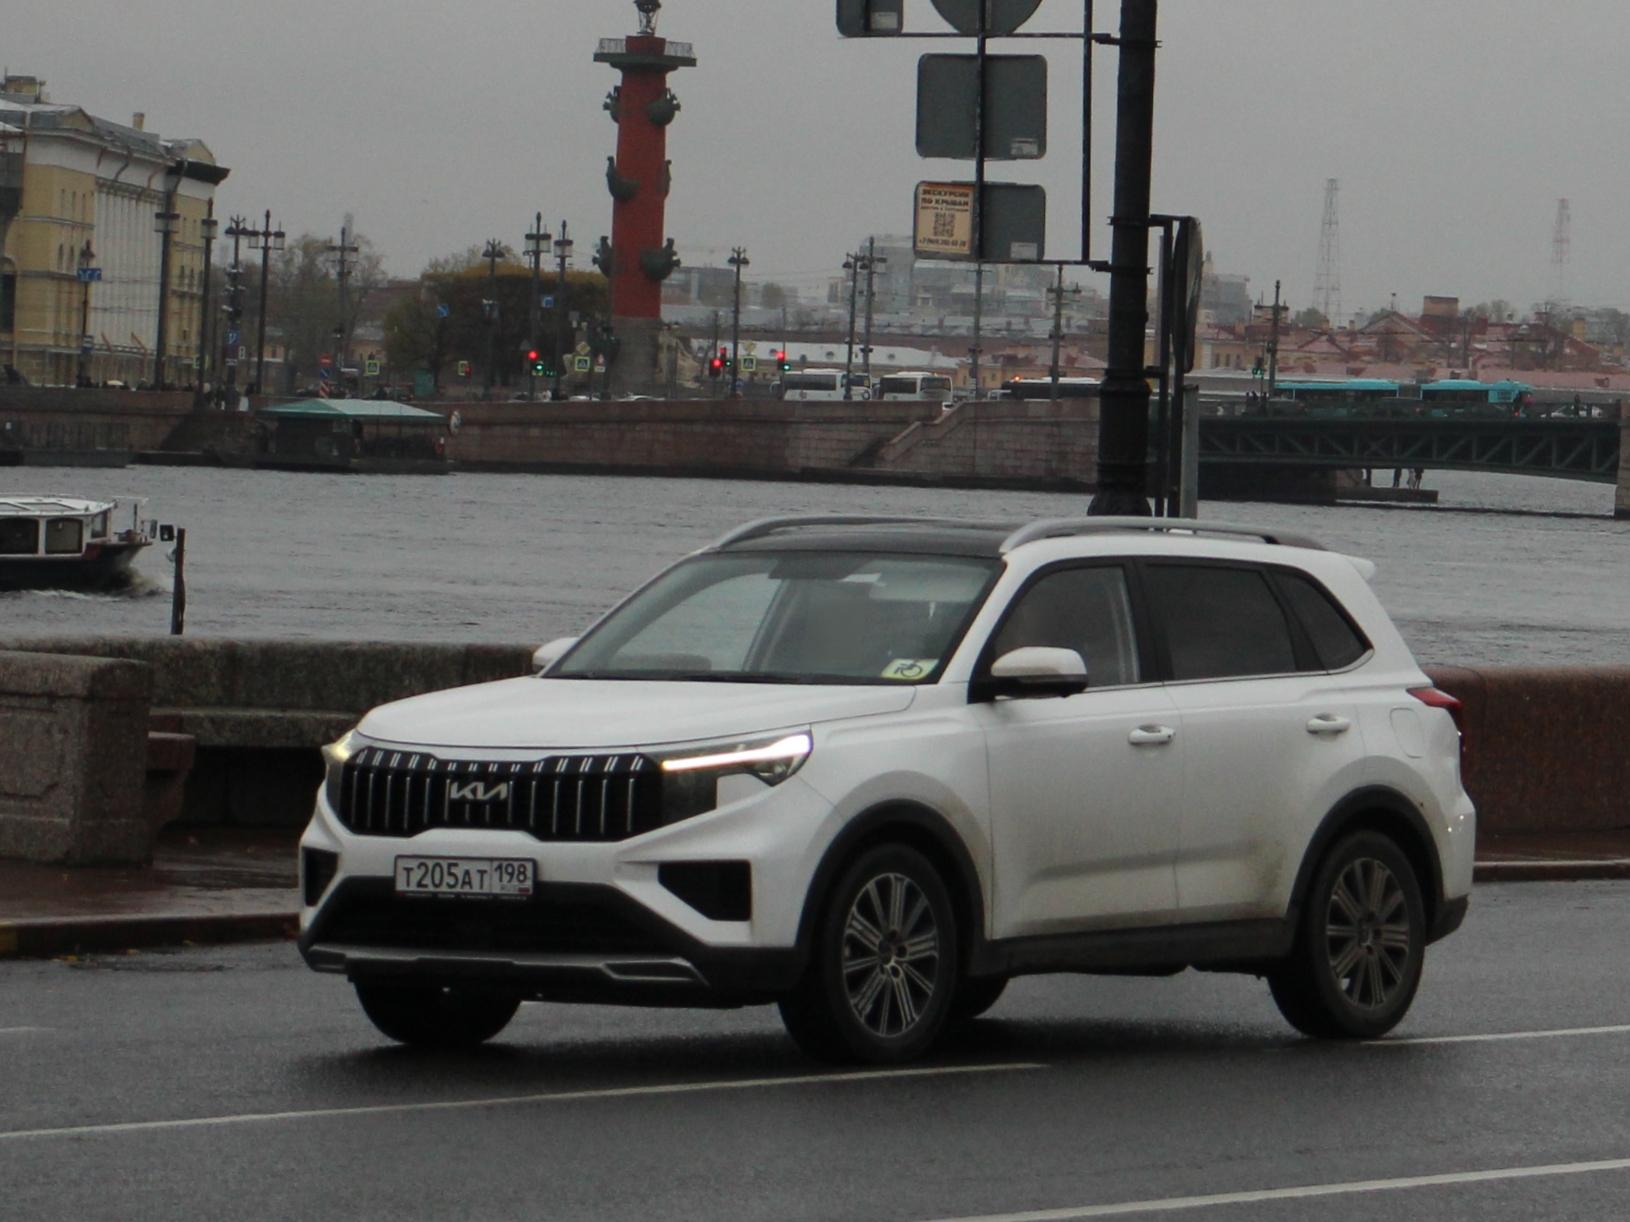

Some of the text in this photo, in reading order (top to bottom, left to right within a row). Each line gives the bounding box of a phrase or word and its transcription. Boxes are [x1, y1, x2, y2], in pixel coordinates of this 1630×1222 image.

[922, 189, 969, 198] ЭКСКУРСИИ
[450, 781, 508, 800] KIA
[494, 862, 528, 884] 198
